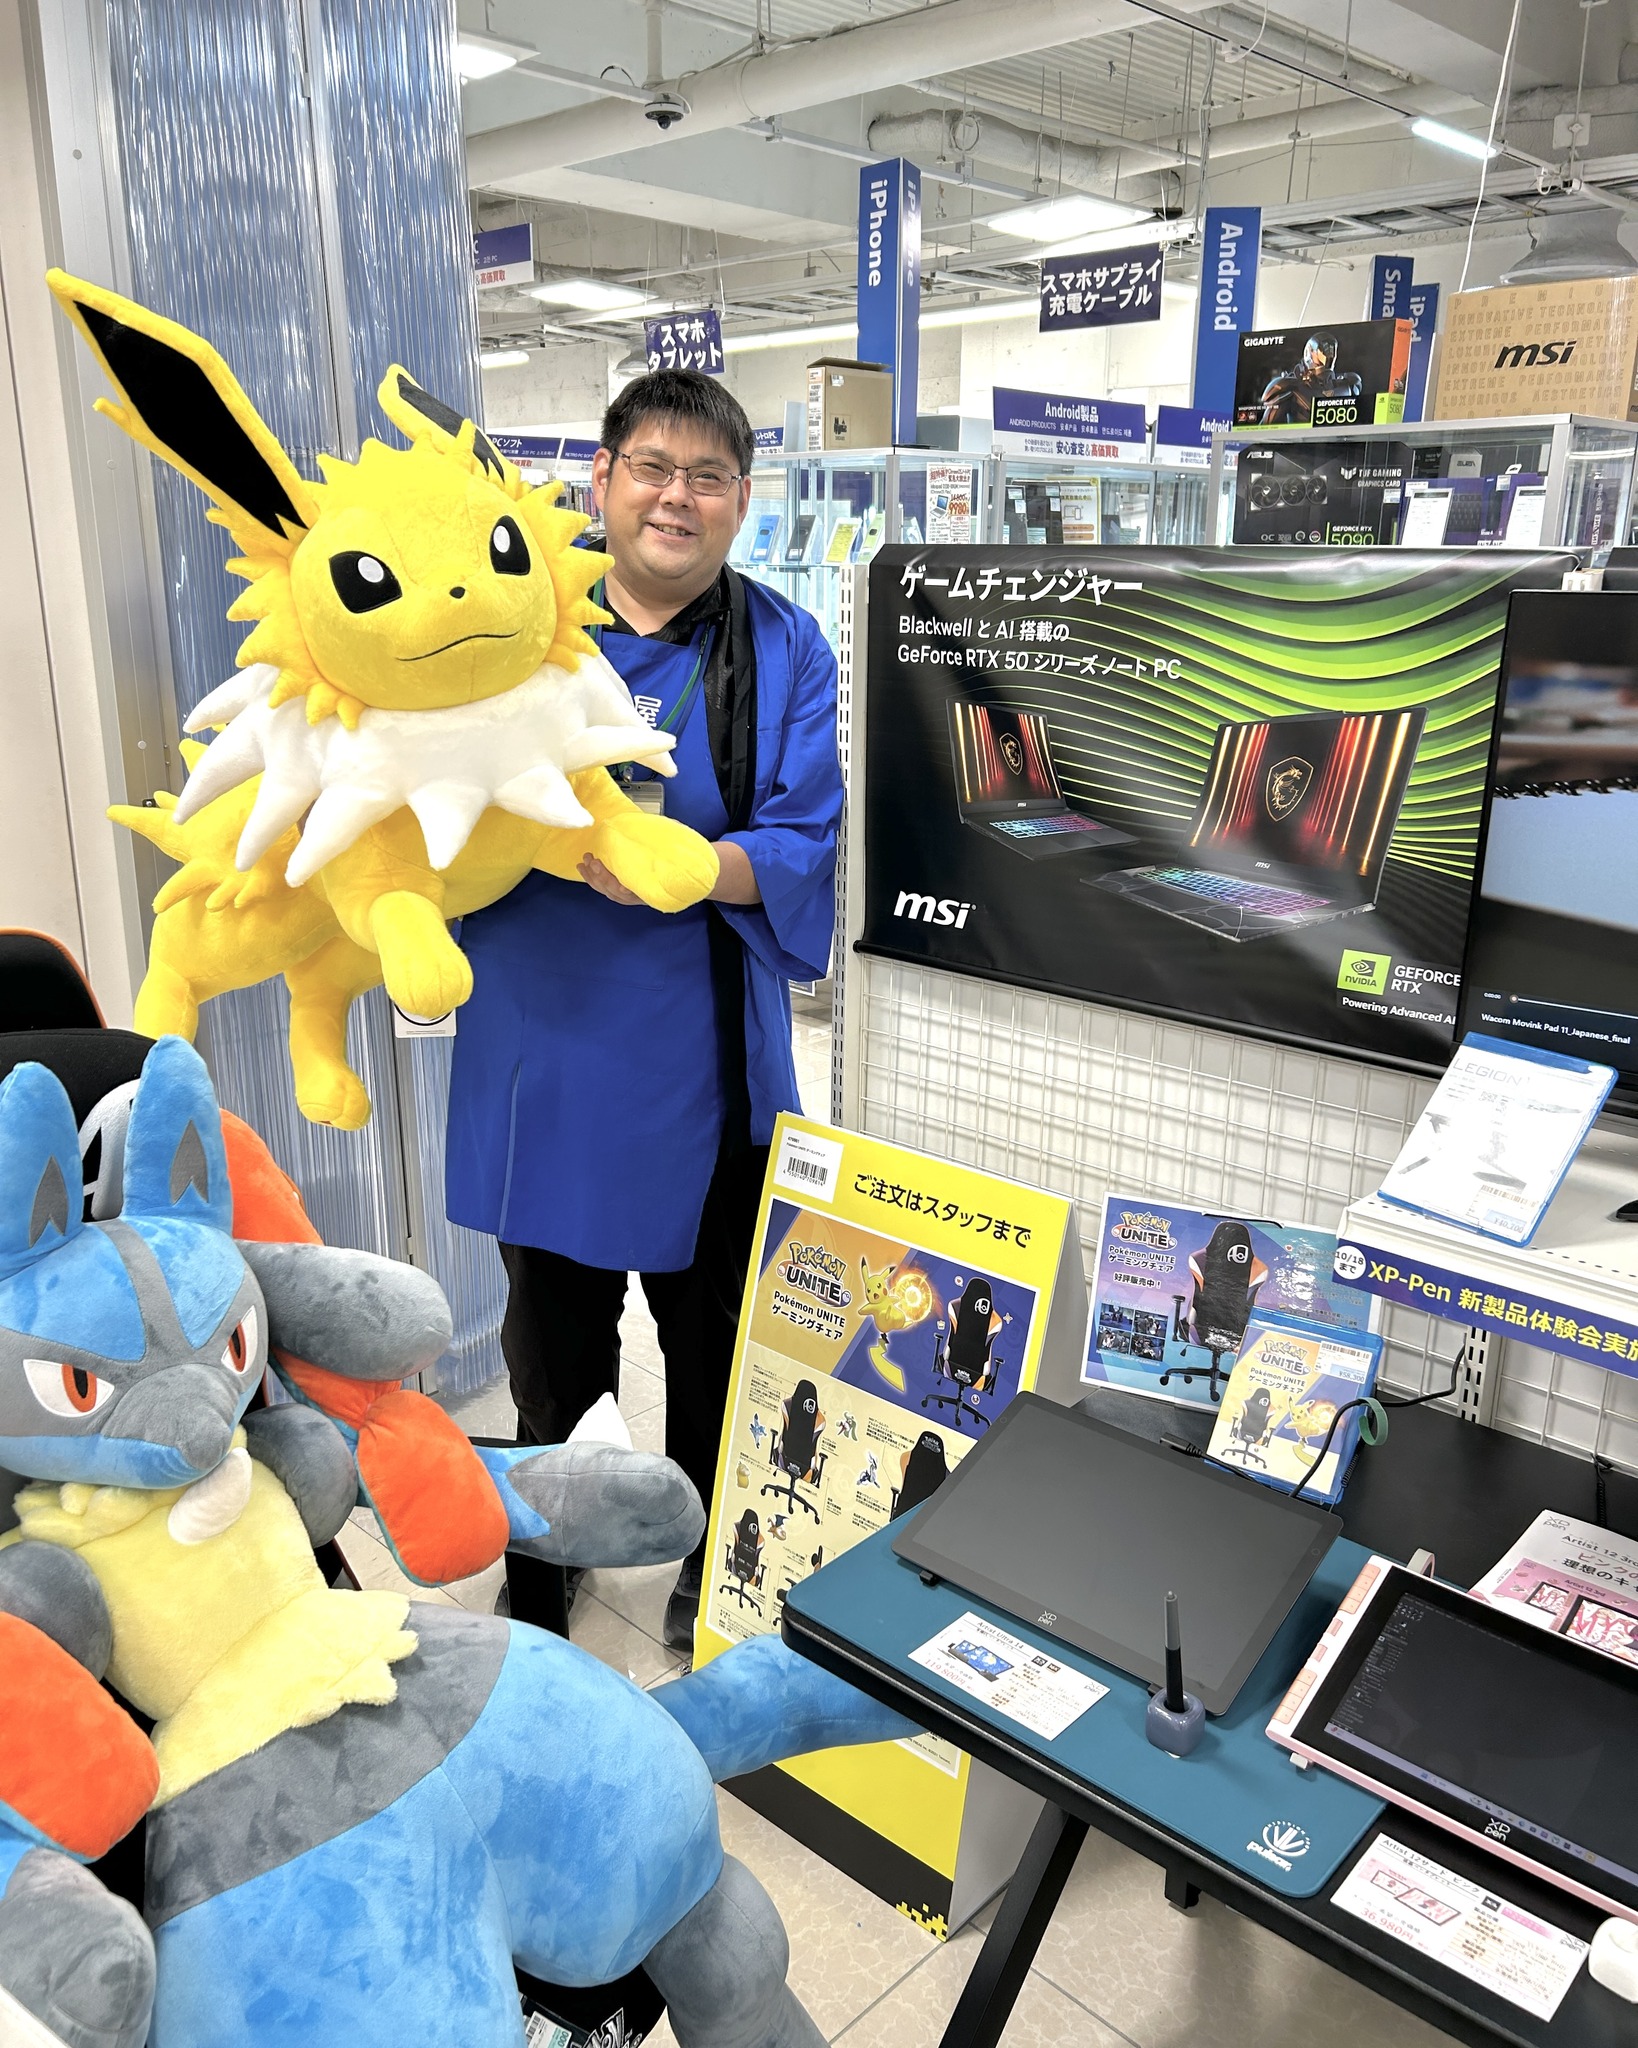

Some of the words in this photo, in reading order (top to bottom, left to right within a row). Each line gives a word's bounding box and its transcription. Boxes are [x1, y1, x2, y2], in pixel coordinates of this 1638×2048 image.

[868, 179, 888, 287] iPhone
[1042, 258, 1162, 295] スマホサプライ
[1213, 222, 1244, 331] Android
[1049, 284, 1153, 317] 充電ケーブル
[661, 318, 706, 348] スマホ
[1243, 336, 1285, 347] GIGABYTE
[648, 342, 722, 374] タブレット
[1494, 340, 1578, 369] msi
[1045, 401, 1099, 424] Android製品
[1317, 399, 1343, 407] GEFORCE
[1009, 418, 1031, 428] ANDROID
[1031, 420, 1057, 430] PRODUCTS
[1315, 407, 1358, 425] 5080
[1246, 451, 1274, 459] ASUS
[1358, 468, 1371, 478] TUF
[1371, 468, 1402, 478] GAMING
[1331, 533, 1375, 545] 5090
[899, 566, 1143, 606] ゲームチェンジャー
[898, 615, 973, 638] Blackwell
[977, 621, 991, 639] と
[995, 620, 1014, 639] AI
[1019, 620, 1070, 643] 搭載の
[897, 644, 963, 666] GeForce
[965, 647, 999, 669] RTX
[1004, 651, 1029, 671] 50
[1153, 657, 1182, 680] PC
[893, 890, 971, 930] msi
[1390, 979, 1423, 995] RTX
[1394, 965, 1462, 987] GEFORCE
[1342, 997, 1388, 1015] Powering
[1389, 1006, 1443, 1023] Advanced
[1443, 1015, 1457, 1025] AI
[1481, 1013, 1511, 1025] Wacom
[1512, 1018, 1543, 1030] Movink
[1544, 1023, 1560, 1033] Pad
[1560, 1026, 1631, 1045] 11_Japanese_final
[1453, 1058, 1522, 1086] LEGION
[854, 1173, 1032, 1249] ご注文はスタッフまで
[1121, 1228, 1168, 1247] UNITE
[1109, 1245, 1147, 1259] Pokémon
[1149, 1253, 1175, 1264] UNITE
[1109, 1255, 1174, 1272] ゲーミングチェア
[1335, 1251, 1364, 1265] 10/18
[1339, 1263, 1357, 1274] まで
[785, 1265, 842, 1303] UNITE
[1368, 1261, 1451, 1303] XP-Pen
[774, 1290, 814, 1315] Pokémon
[816, 1308, 846, 1328] UNITE
[772, 1304, 843, 1340] ゲーミングチェア
[1261, 1353, 1304, 1373] UNITE
[1248, 1375, 1304, 1394] ゲーミングチェア
[1250, 1367, 1282, 1380] Pokémon
[1283, 1376, 1306, 1387] UNITE
[1562, 1535, 1599, 1551] Artist
[1603, 1549, 1618, 1558] 12
[1561, 1558, 1638, 1592] 理想のキ
[1564, 1579, 1585, 1589] Artist
[977, 1621, 997, 1635] Artist
[1038, 1616, 1053, 1627] pen
[1484, 1826, 1507, 1842] pen
[1382, 1839, 1408, 1855] Artist
[1452, 1876, 1481, 1893] ピンク
